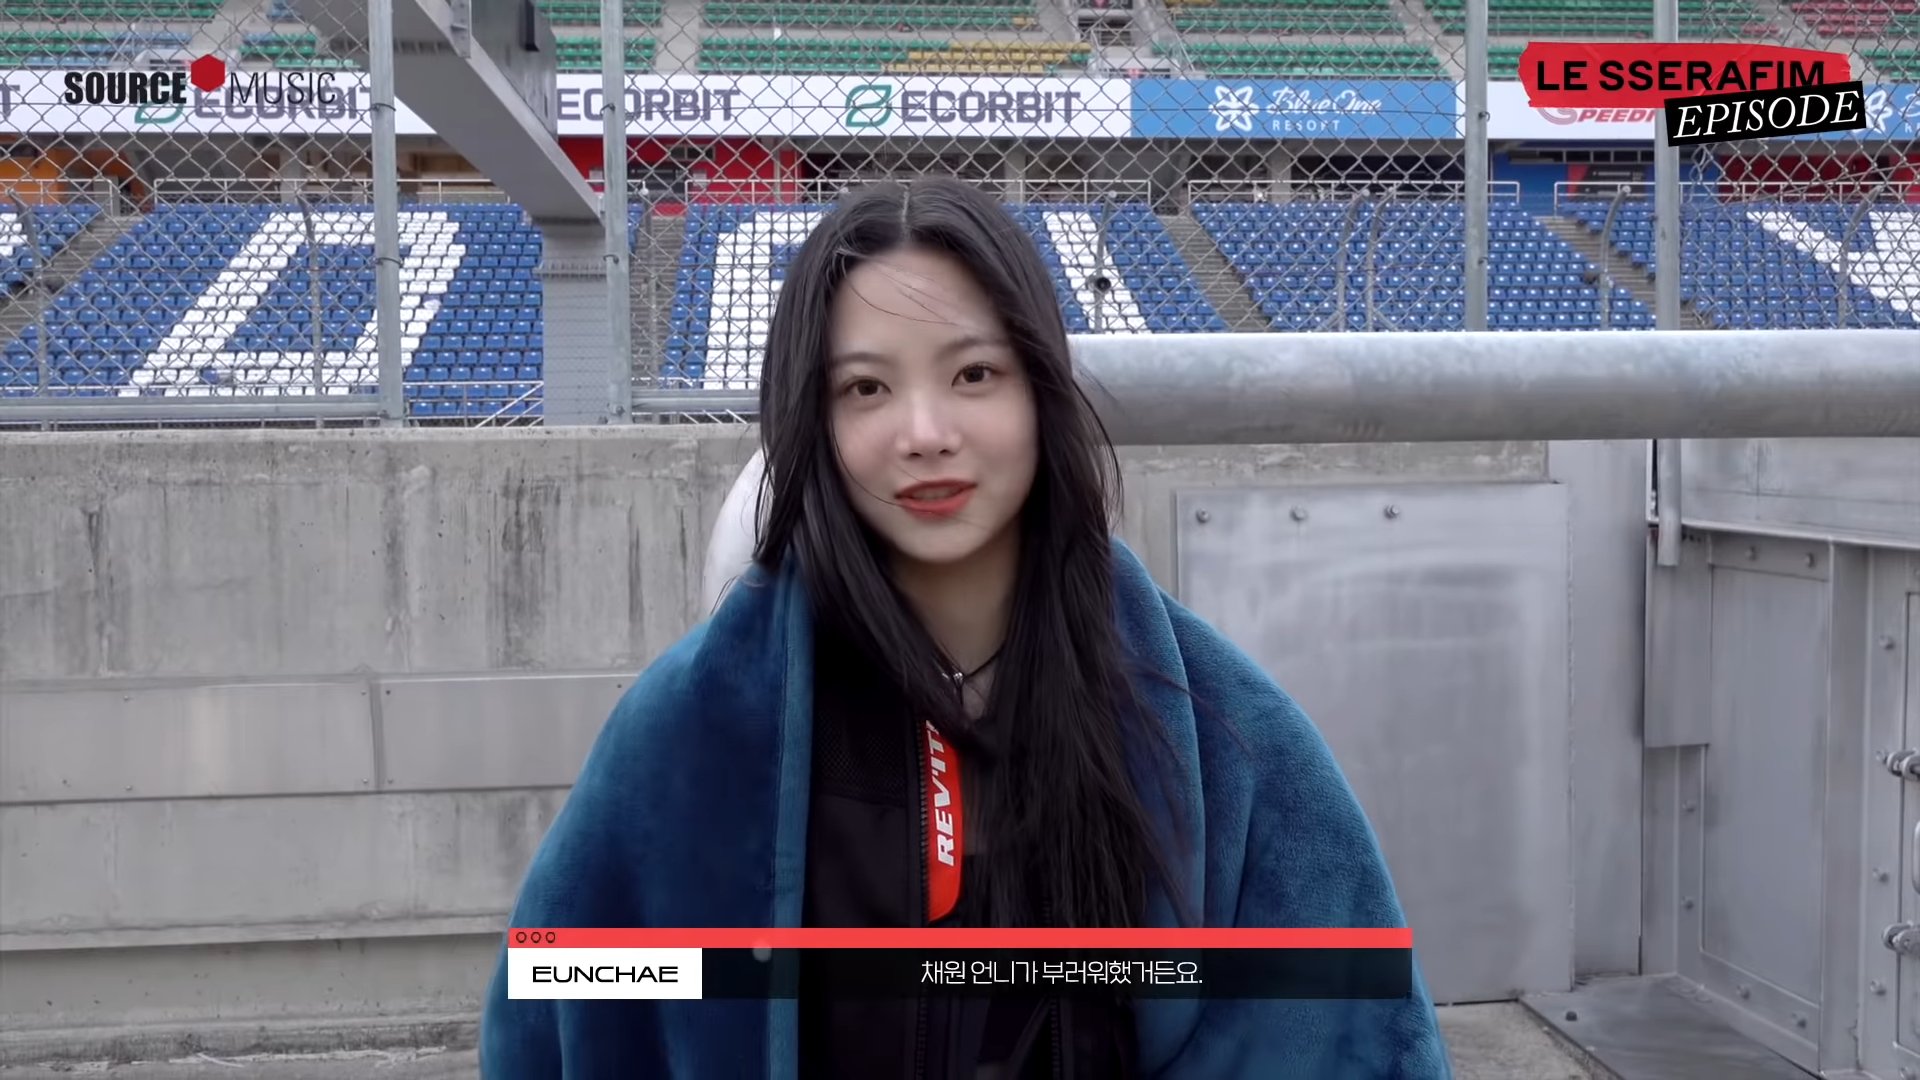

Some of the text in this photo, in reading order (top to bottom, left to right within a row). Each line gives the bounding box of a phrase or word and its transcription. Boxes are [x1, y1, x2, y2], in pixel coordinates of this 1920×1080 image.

[193, 86, 371, 119] ECORBI
[901, 90, 1081, 123] ECORBIT
[1272, 119, 1341, 131] RESORT
